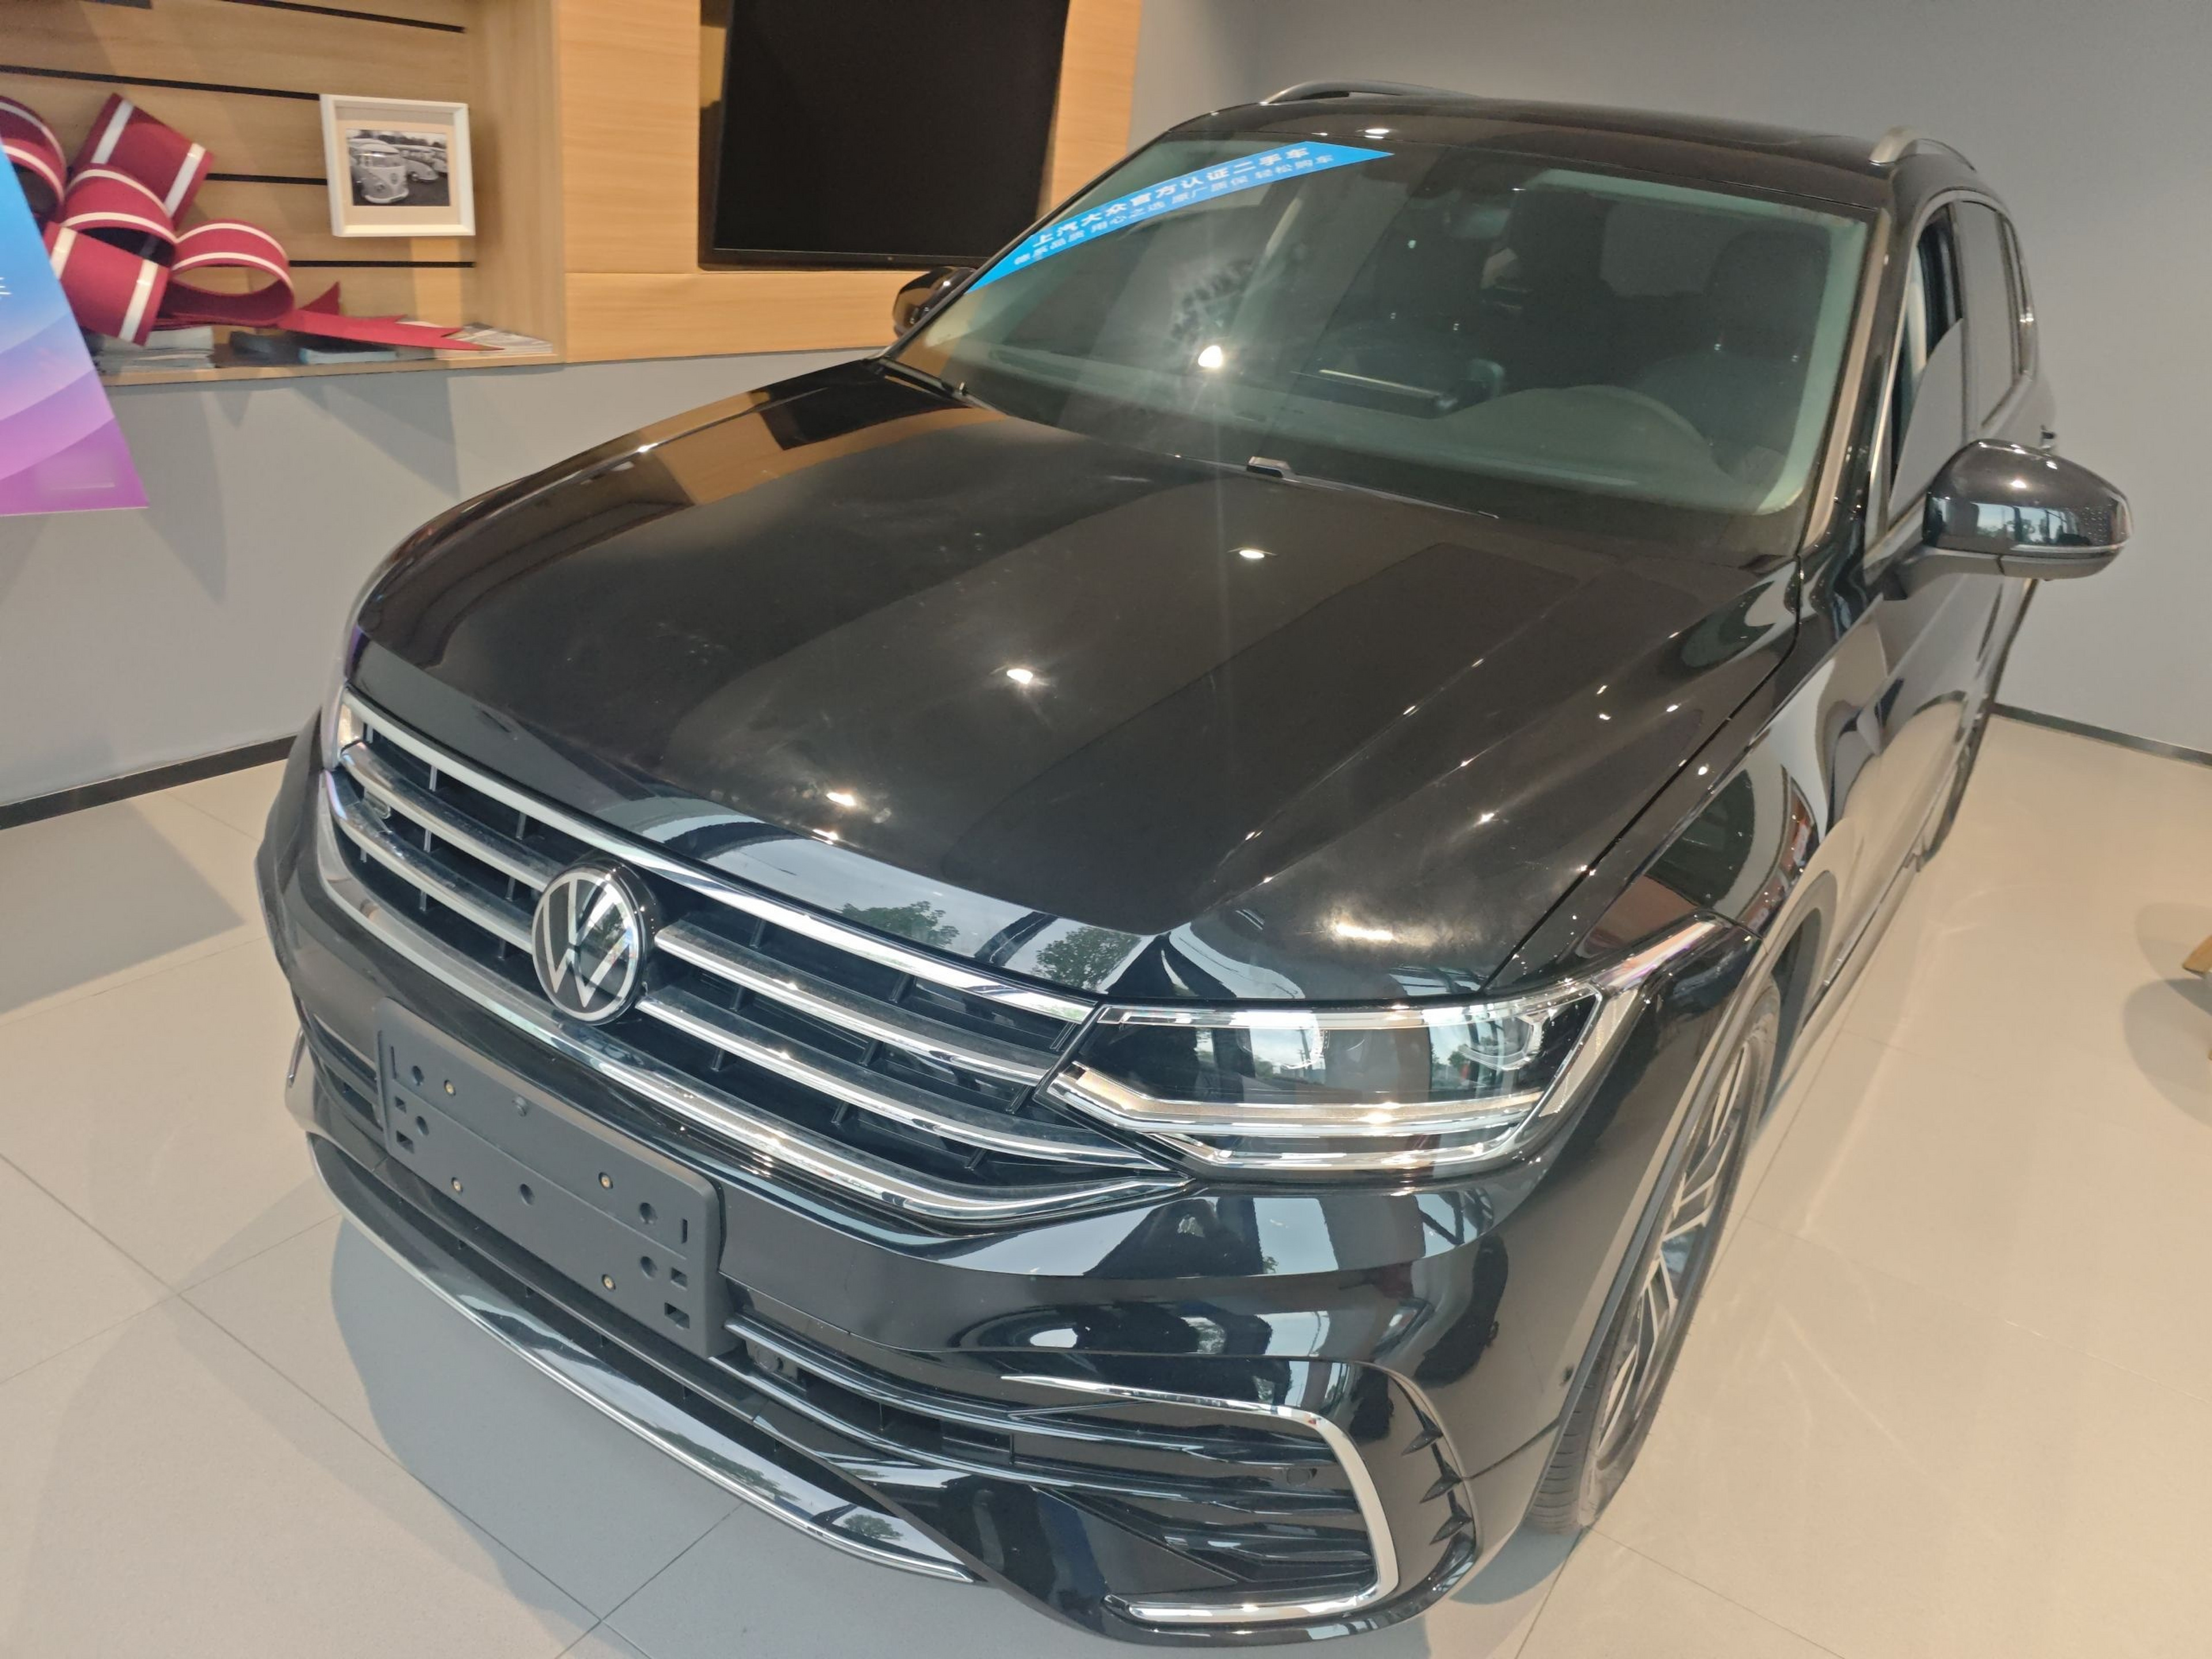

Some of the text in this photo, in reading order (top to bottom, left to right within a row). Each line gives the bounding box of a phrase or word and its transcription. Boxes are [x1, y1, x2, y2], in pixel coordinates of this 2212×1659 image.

[1033, 147, 1309, 247] 上汽大众官方认证二手车
